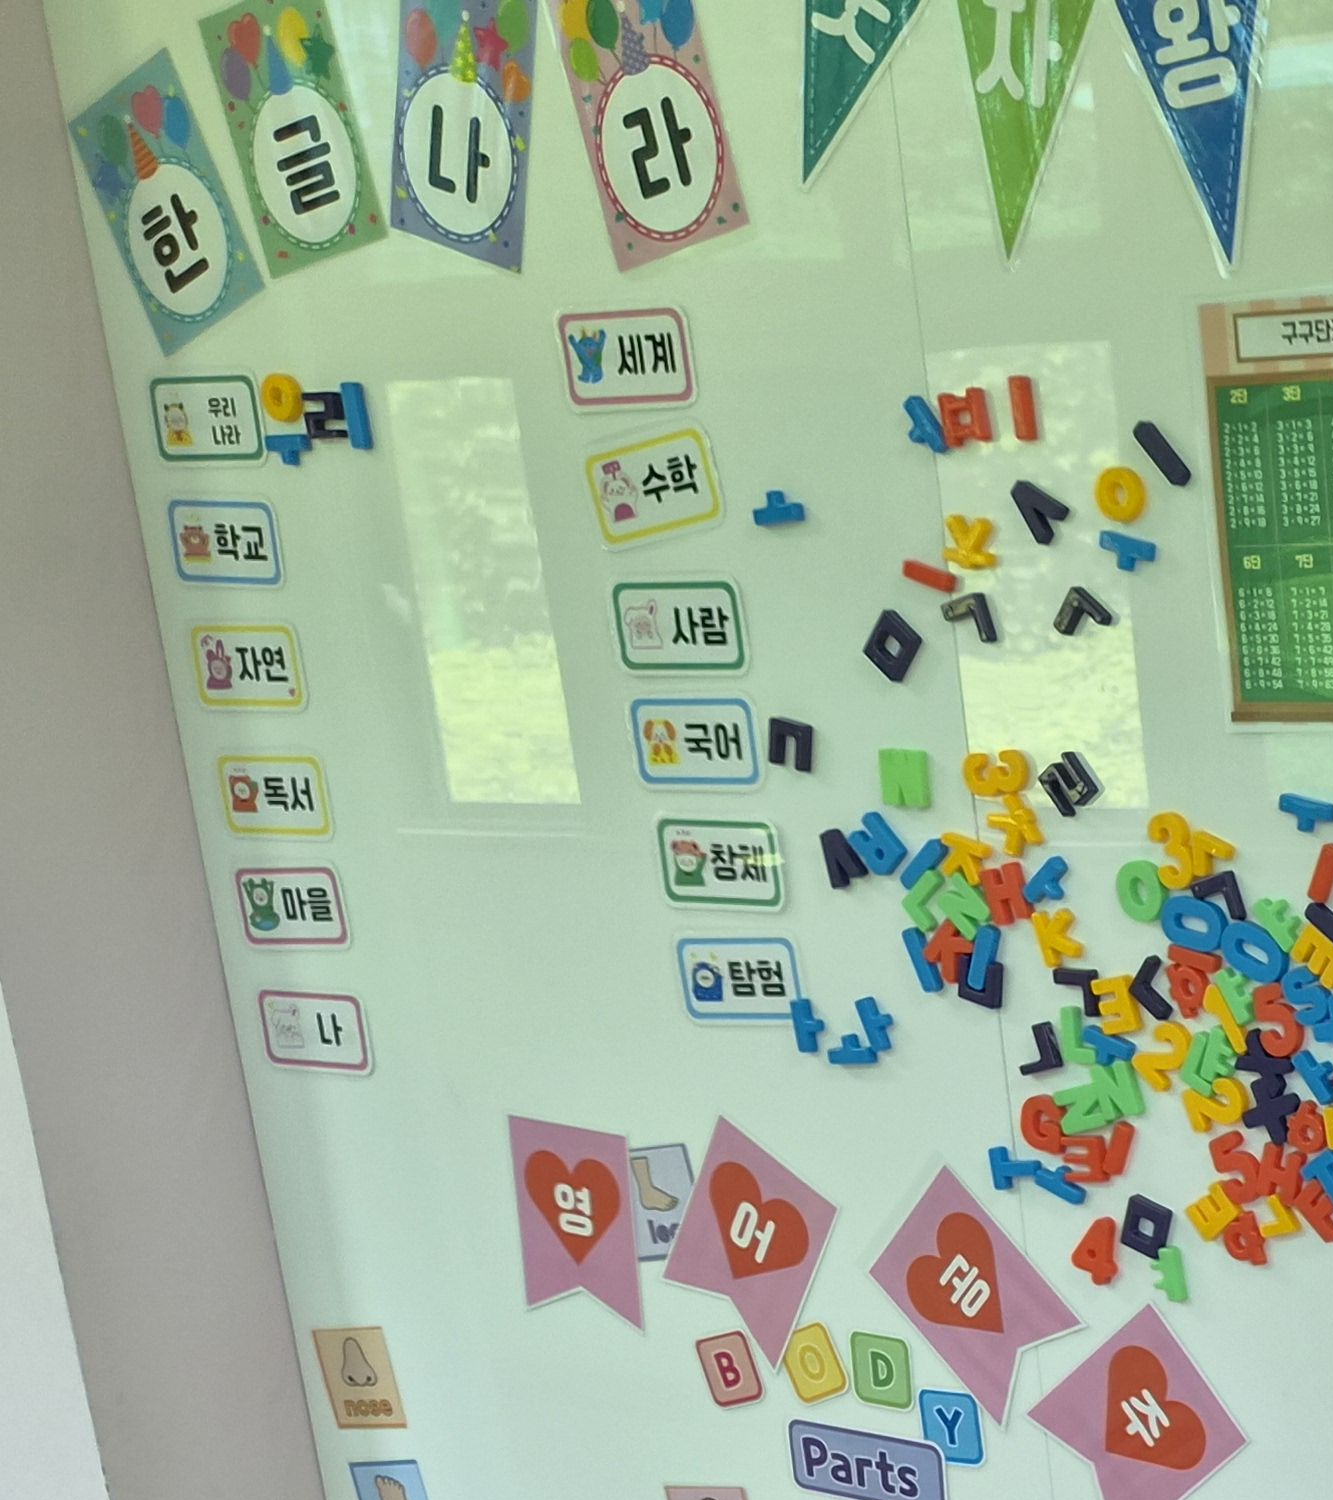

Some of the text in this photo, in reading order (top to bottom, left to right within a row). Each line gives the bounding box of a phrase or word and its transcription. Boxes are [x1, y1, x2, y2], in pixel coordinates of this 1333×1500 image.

[141, 96, 693, 294] 한 글 나 라
[617, 331, 677, 377] 세계
[207, 397, 238, 419] 우리
[212, 425, 241, 446] 나라
[642, 456, 697, 502] 수학
[214, 524, 268, 561] 학교
[672, 606, 728, 647] 사람
[237, 647, 289, 684] 자연
[683, 722, 742, 762] 국어
[264, 775, 314, 814] 독서
[711, 844, 766, 883] 창체
[282, 886, 333, 924] 마을
[728, 961, 786, 999] 탐험
[317, 1014, 342, 1045] 나
[553, 1181, 1170, 1447] 영 어 동 사
[344, 1398, 393, 1418] nose
[715, 1347, 963, 1445] B O D Y
[801, 1435, 920, 1498] Parts
